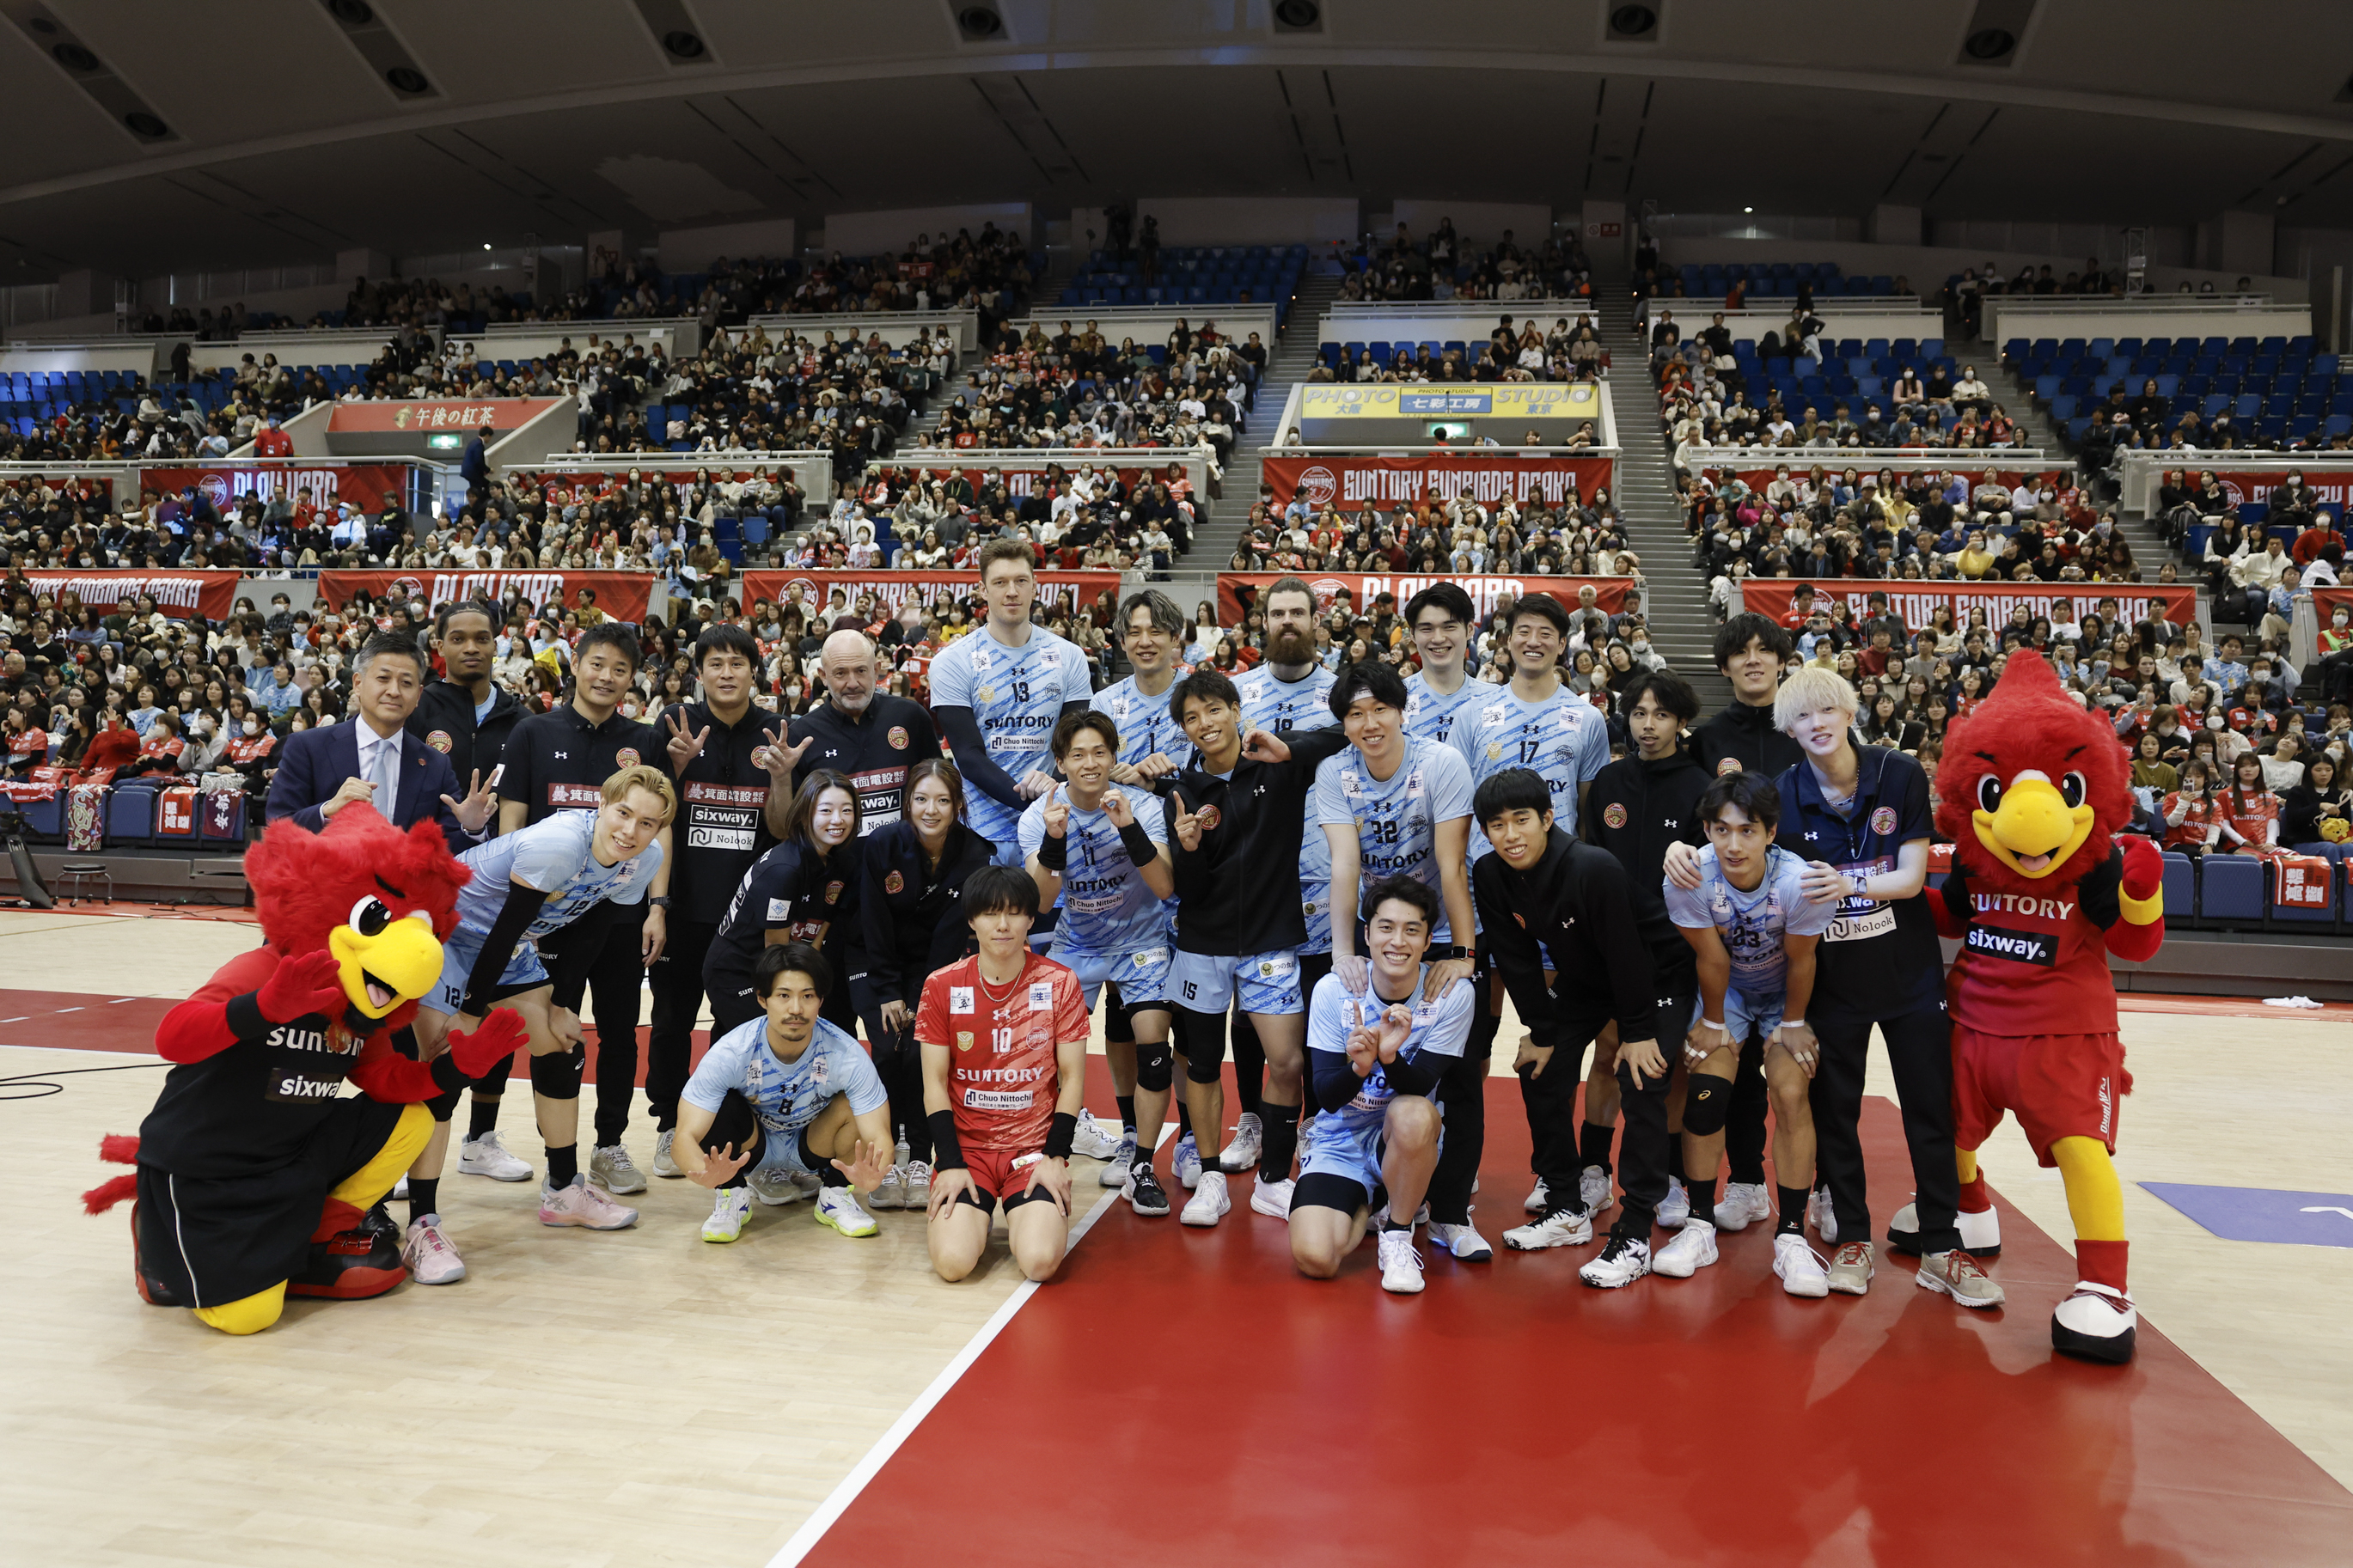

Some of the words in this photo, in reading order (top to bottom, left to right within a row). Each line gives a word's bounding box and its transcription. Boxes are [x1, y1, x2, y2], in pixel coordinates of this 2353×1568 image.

[1305, 388, 1396, 403] PHOTO
[1412, 398, 1482, 409] 七彩工房
[1495, 387, 1592, 403] STUDIO
[415, 406, 495, 427] 午後の紅茶
[1335, 404, 1362, 415] 大阪
[1527, 403, 1553, 415] 東京
[1343, 469, 1423, 501] SUNTORY
[1427, 469, 1513, 502] SUNBIRDS
[1518, 471, 1576, 503] OSAKA
[145, 577, 205, 608] OSAKA
[1011, 681, 1030, 703] 13
[984, 717, 1054, 730] SUNTORY
[1520, 741, 1539, 763] 17
[570, 789, 601, 802] 箕面電
[704, 788, 752, 802] 箕面電設
[861, 796, 894, 808] xway
[2245, 799, 2256, 808] 12
[2191, 802, 2202, 812] 12
[695, 808, 749, 827] sixway
[717, 834, 752, 845] Nolook
[1082, 844, 1096, 866] 11
[1361, 847, 1429, 869] UNTORY
[1067, 872, 1128, 892] UNTORY
[562, 900, 590, 916] 12
[1097, 895, 1122, 906] Nittochi
[1970, 894, 2075, 920] SUNTORY
[1854, 916, 1893, 933] Nolook
[1733, 925, 1761, 948] 23
[1968, 929, 2042, 960] sixway
[444, 985, 461, 1009] 12
[1036, 991, 1043, 1001] 生
[1183, 980, 1198, 1000] 15
[266, 1026, 364, 1057] SUNOR
[991, 1027, 1012, 1052] 10
[956, 1066, 1044, 1083] SUNTORY
[279, 1075, 341, 1097] sixwa
[978, 1093, 998, 1101] Chuo
[1000, 1093, 1031, 1102] Nittochi
[778, 1099, 794, 1115] 8
[2100, 1103, 2111, 1134] HARD
